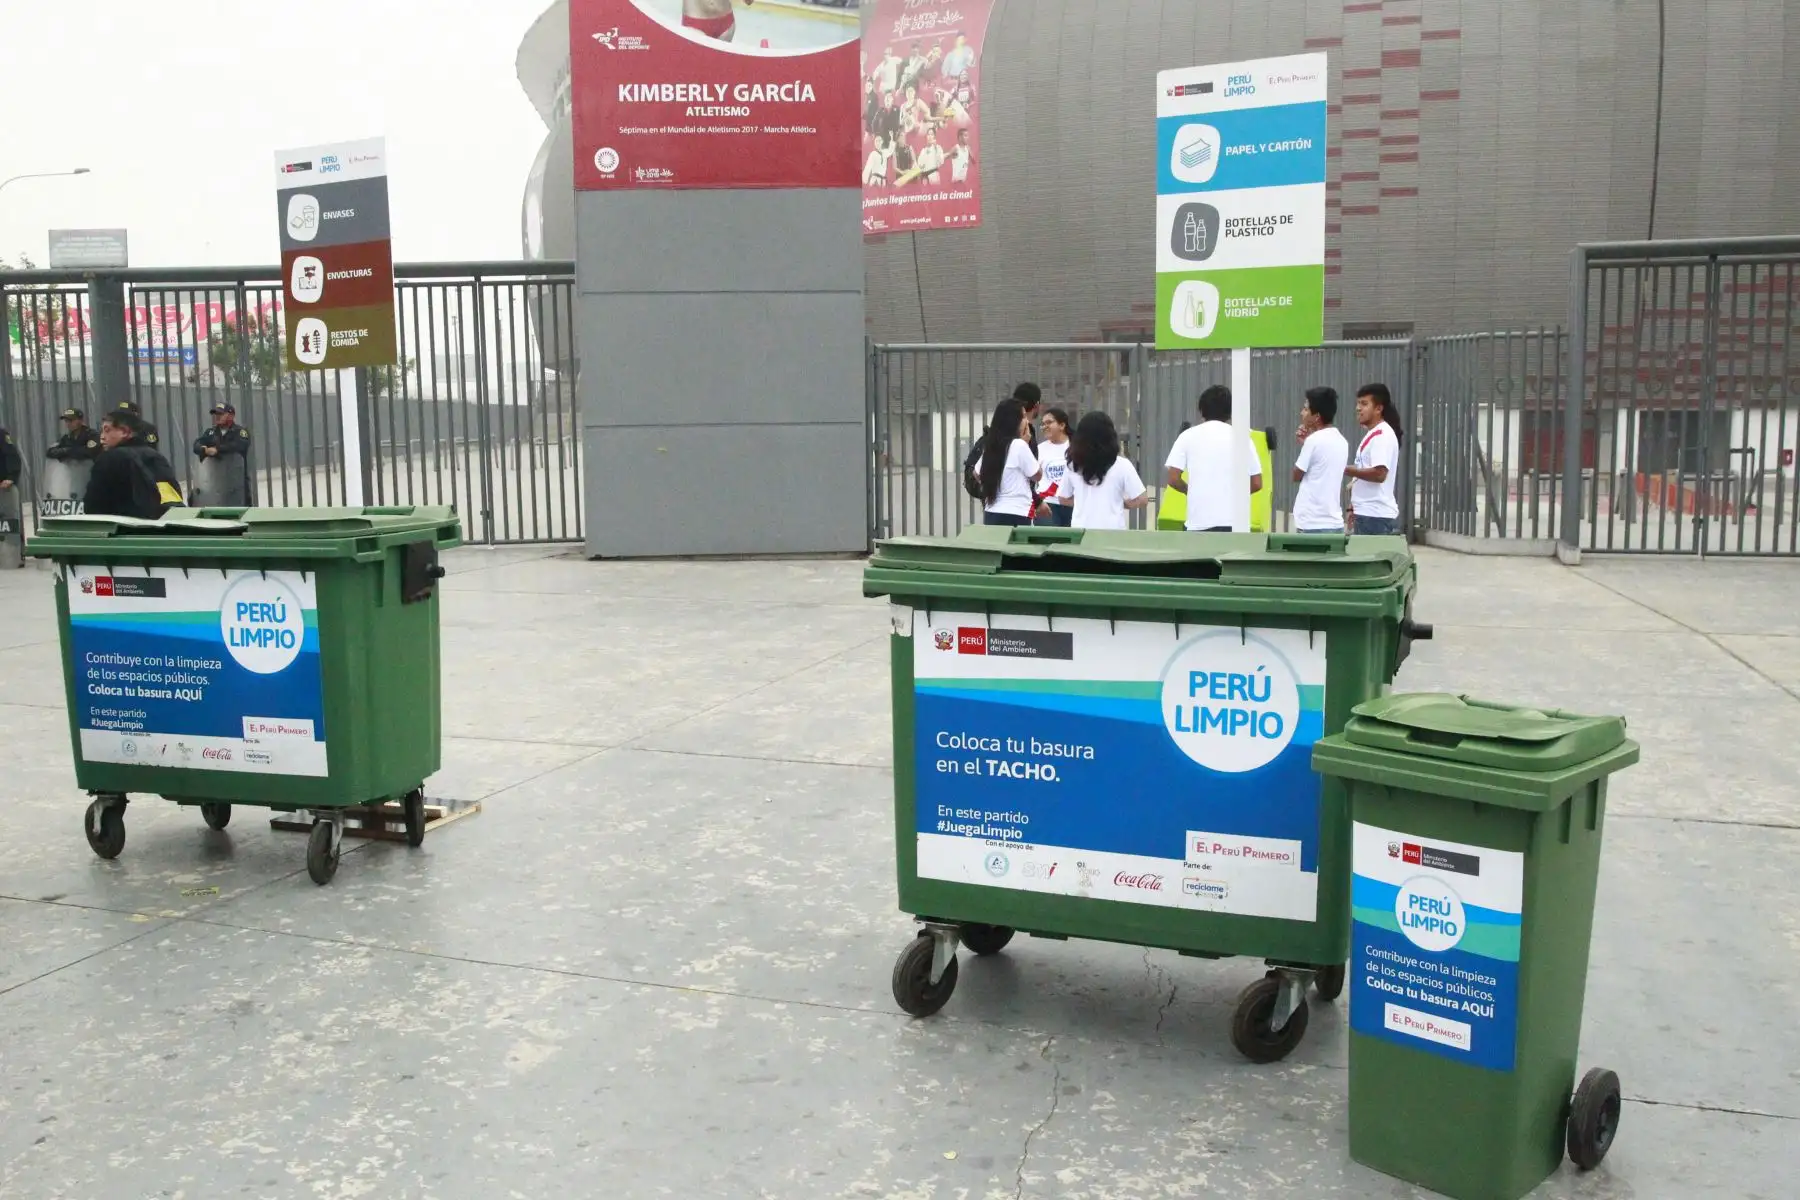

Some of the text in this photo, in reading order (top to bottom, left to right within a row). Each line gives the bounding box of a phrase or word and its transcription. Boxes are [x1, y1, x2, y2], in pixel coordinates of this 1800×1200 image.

[618, 80, 816, 102] KIMBERLY GARCÍA
[1224, 85, 1256, 97] LIMPIO
[686, 106, 750, 117] ATLETISMO
[619, 125, 648, 134] Séptima
[1225, 137, 1312, 156] PAPEL Y CARTÓN
[889, 194, 931, 205] llegaremos
[940, 191, 948, 200] la
[949, 189, 973, 200] cima!
[322, 208, 355, 220] ENVASES
[1225, 215, 1293, 228] BOTELLAS DE
[1225, 226, 1275, 238] PLASTICO
[326, 268, 372, 281] ENVOLTURAS
[1224, 295, 1293, 308] BOTELLAS DE
[1224, 307, 1259, 318] VIDRIO
[330, 328, 368, 339] RESTOS DE
[331, 337, 360, 347] COMIDA
[236, 597, 287, 623] PERÚ
[230, 627, 296, 649] LIMPIO
[960, 636, 983, 645] PERÚ
[990, 638, 1026, 647] Ministerio
[1002, 645, 1037, 654] Ambiente
[86, 652, 222, 671] Contribuye con la limpieza
[87, 668, 210, 685] de los espacios públicos.
[1189, 665, 1272, 703] PERÚ
[88, 684, 203, 702] Coloca tu basura AQUÍ
[90, 706, 147, 719] En este partido
[91, 717, 144, 731] #JuegaLimpio
[1175, 705, 1284, 739] LIMPIO
[936, 731, 1095, 760] Coloca tu basura
[936, 758, 1061, 782] en el TACHO.
[937, 805, 1029, 825] En este partido
[937, 820, 1023, 841] #JuegaLimpio
[998, 840, 1005, 848] el
[1005, 843, 1025, 851] apoyo
[1196, 841, 1290, 861] EL PERÚ PRIMERO
[1183, 862, 1201, 870] Parte
[1409, 893, 1451, 917] PERÚ
[1402, 911, 1458, 937] LIMPIO
[1366, 945, 1497, 986] Contribuye con la limpieza
[1366, 961, 1495, 1002] de los espacios públicos.
[1366, 975, 1495, 1019] Coloca tu basura AQUÍ
[1392, 1012, 1403, 1025] EL
[1426, 1022, 1463, 1041] PRIMERO
